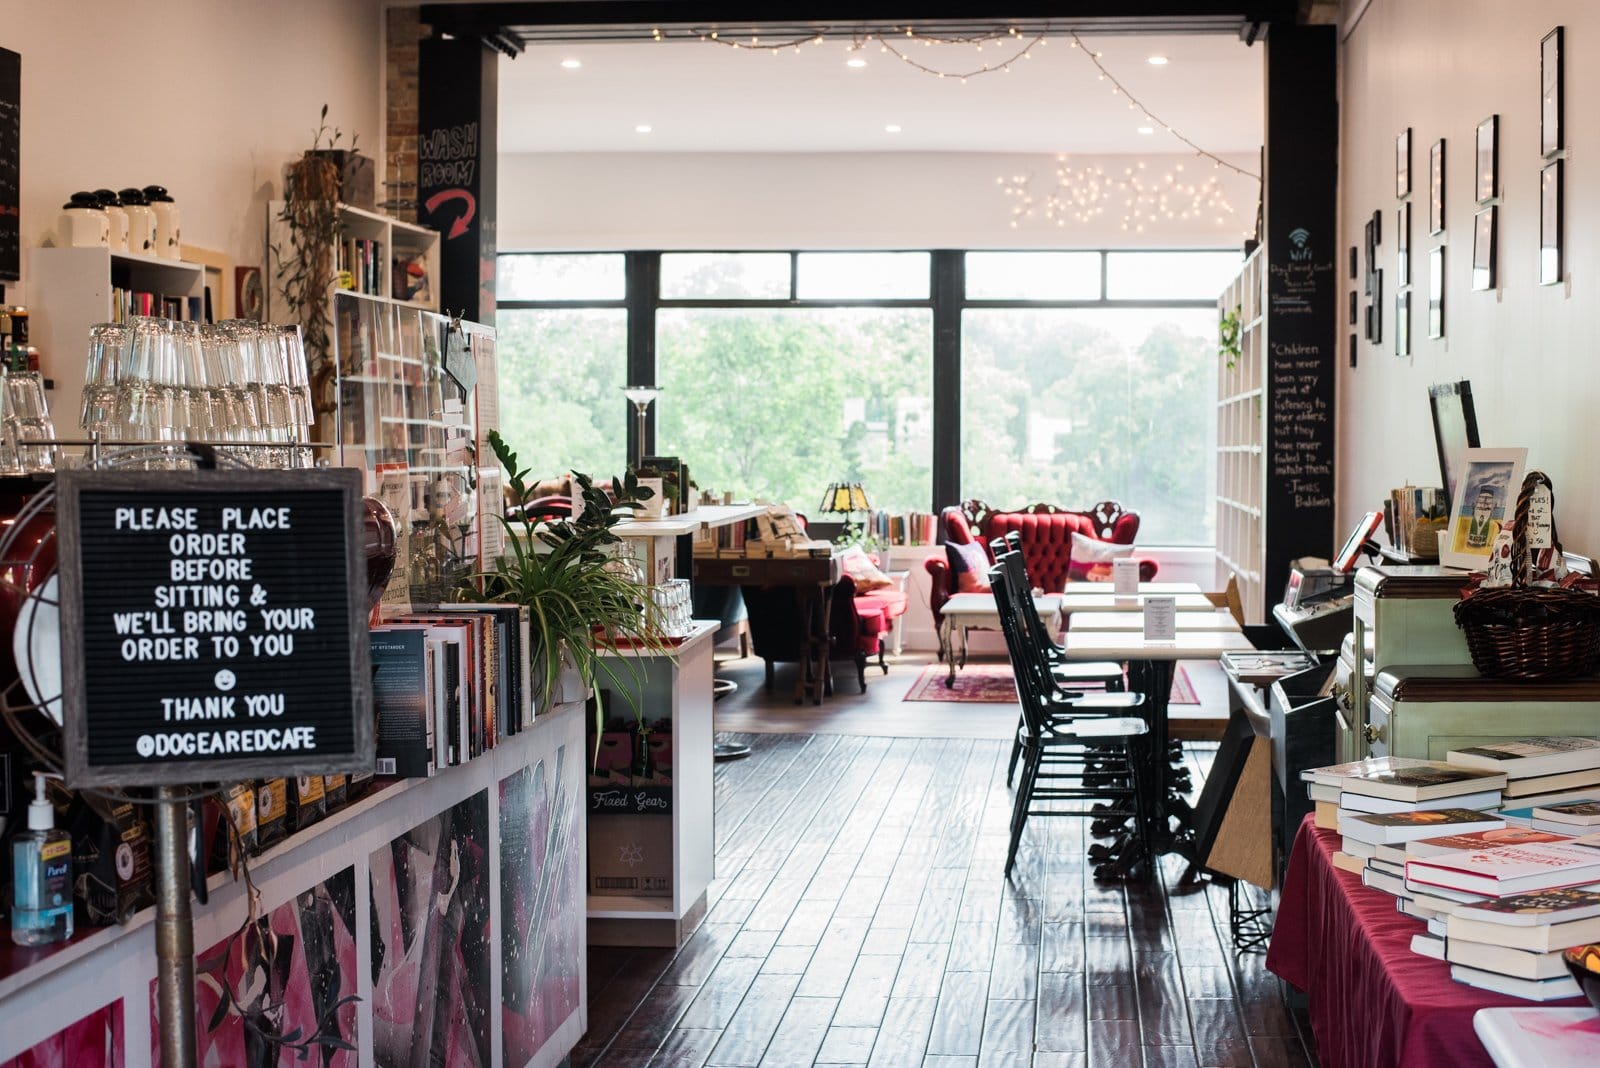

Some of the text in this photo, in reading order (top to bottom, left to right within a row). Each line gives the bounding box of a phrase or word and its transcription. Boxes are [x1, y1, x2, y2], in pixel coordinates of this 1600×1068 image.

[419, 122, 478, 161] WASH
[421, 160, 474, 187] ROOM
[1296, 360, 1321, 369] never
[1274, 397, 1326, 413] listening to
[1294, 424, 1314, 439] they
[1296, 441, 1322, 450] never
[1305, 453, 1316, 463] to
[115, 507, 291, 530] PLEASE PLACE
[169, 533, 246, 555] ORDER
[170, 558, 252, 581] BEFORE
[154, 583, 268, 608] SITTING &
[113, 607, 315, 634] WE'LL BRING YOUR
[121, 634, 294, 661] ORDER TO YOU
[161, 693, 285, 721] THANK YOU
[136, 726, 316, 757] @DOGEAREDCAFE
[592, 790, 668, 811] Fixed Gear
